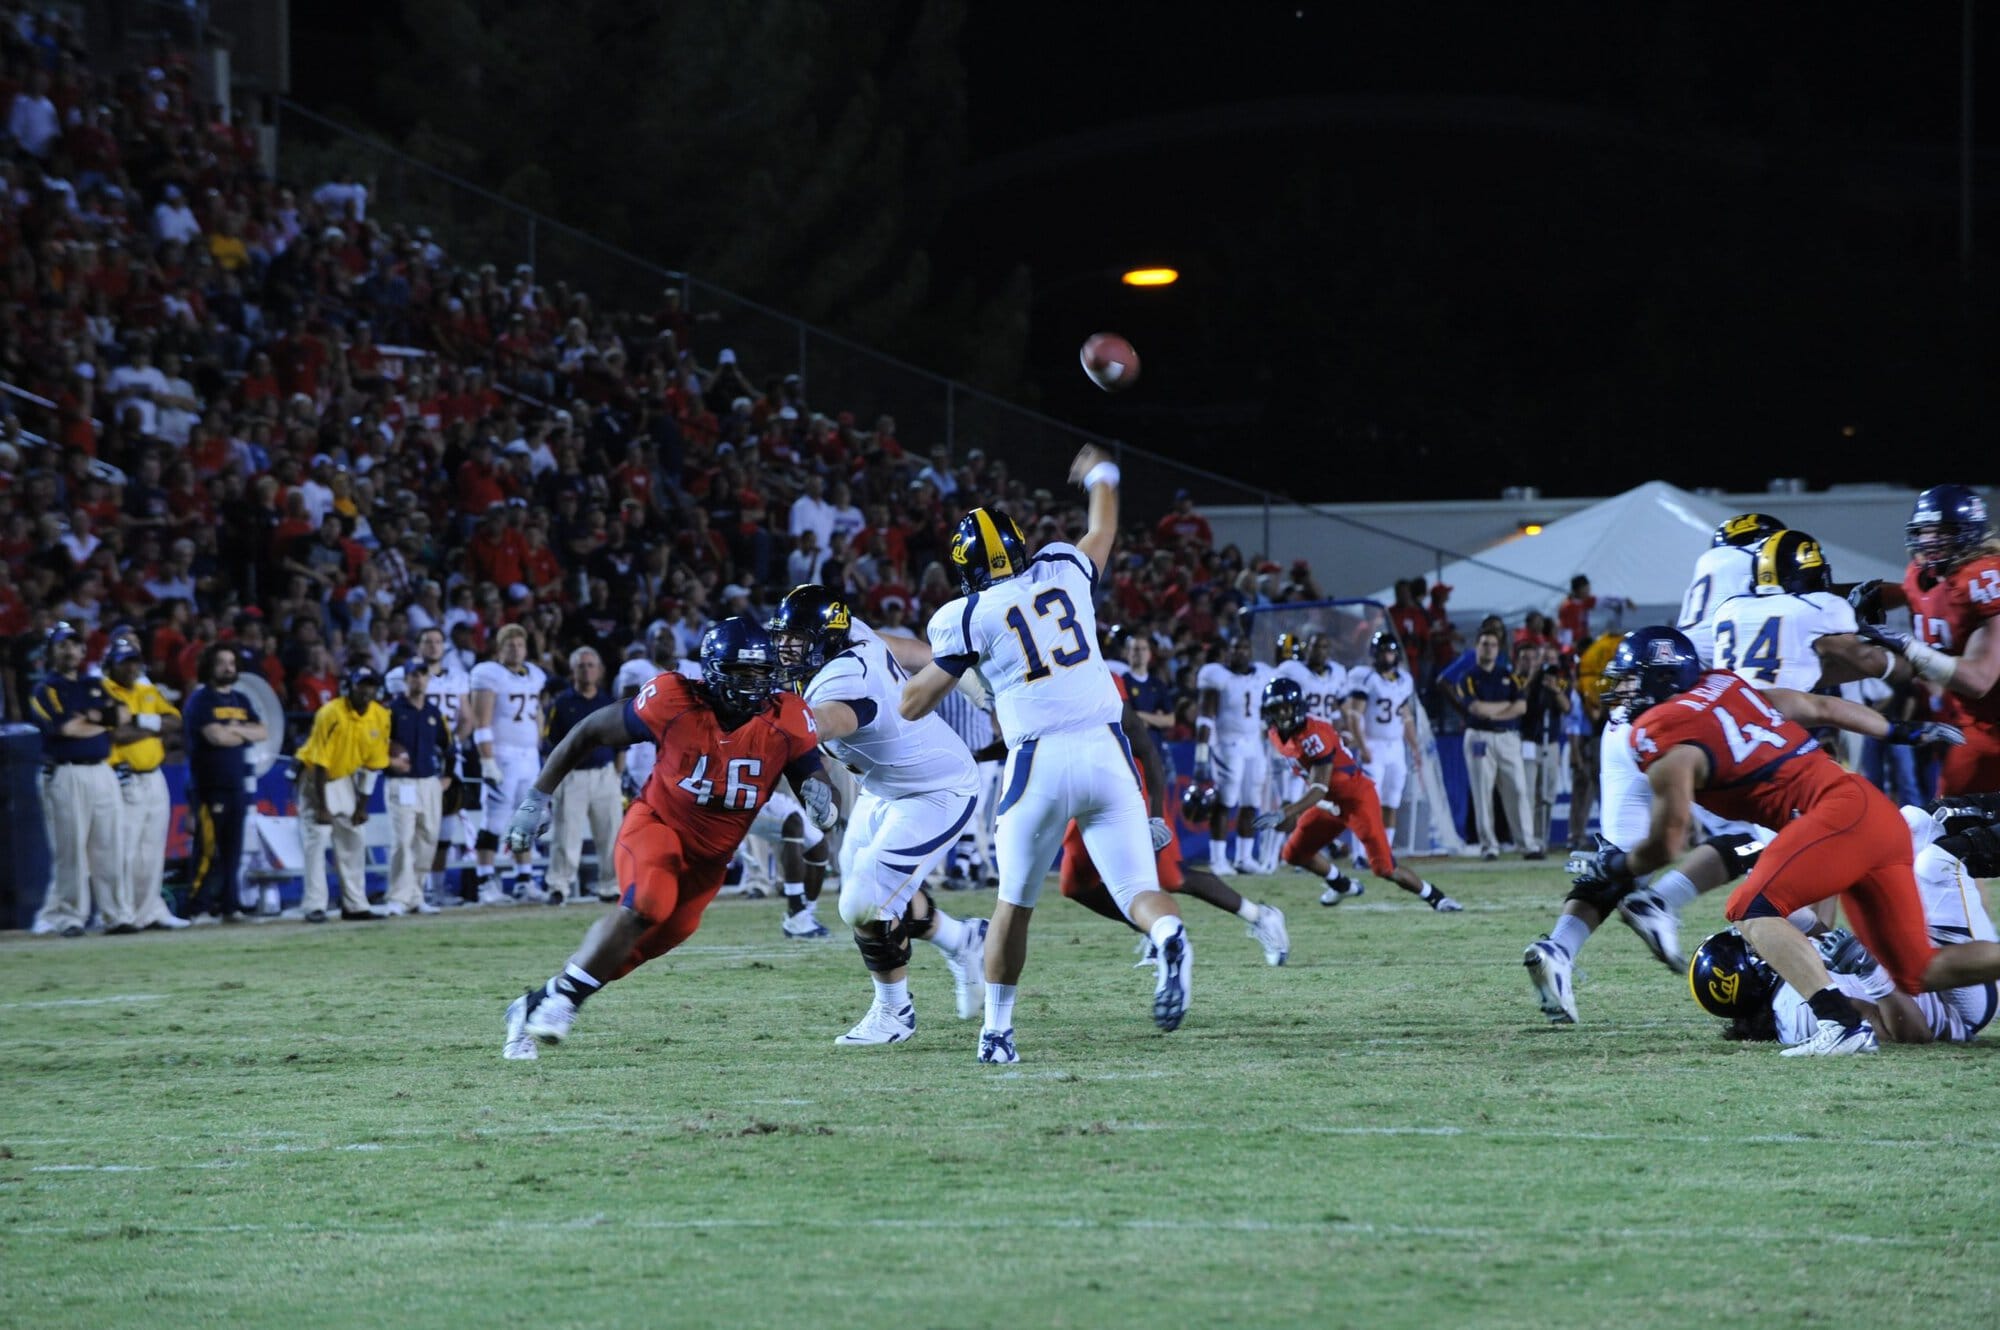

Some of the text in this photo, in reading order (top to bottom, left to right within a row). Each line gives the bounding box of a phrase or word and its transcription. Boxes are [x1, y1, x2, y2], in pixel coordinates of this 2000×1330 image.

[825, 601, 849, 629] Cal
[1004, 587, 1092, 684] 13
[1648, 638, 1682, 665] A
[1716, 616, 1784, 685] 34
[634, 676, 658, 710] 6
[802, 708, 817, 734] 4
[1712, 687, 1788, 763] 44
[1302, 733, 1325, 757] 23
[677, 755, 762, 810] 46
[1708, 966, 1739, 1005] Cal
